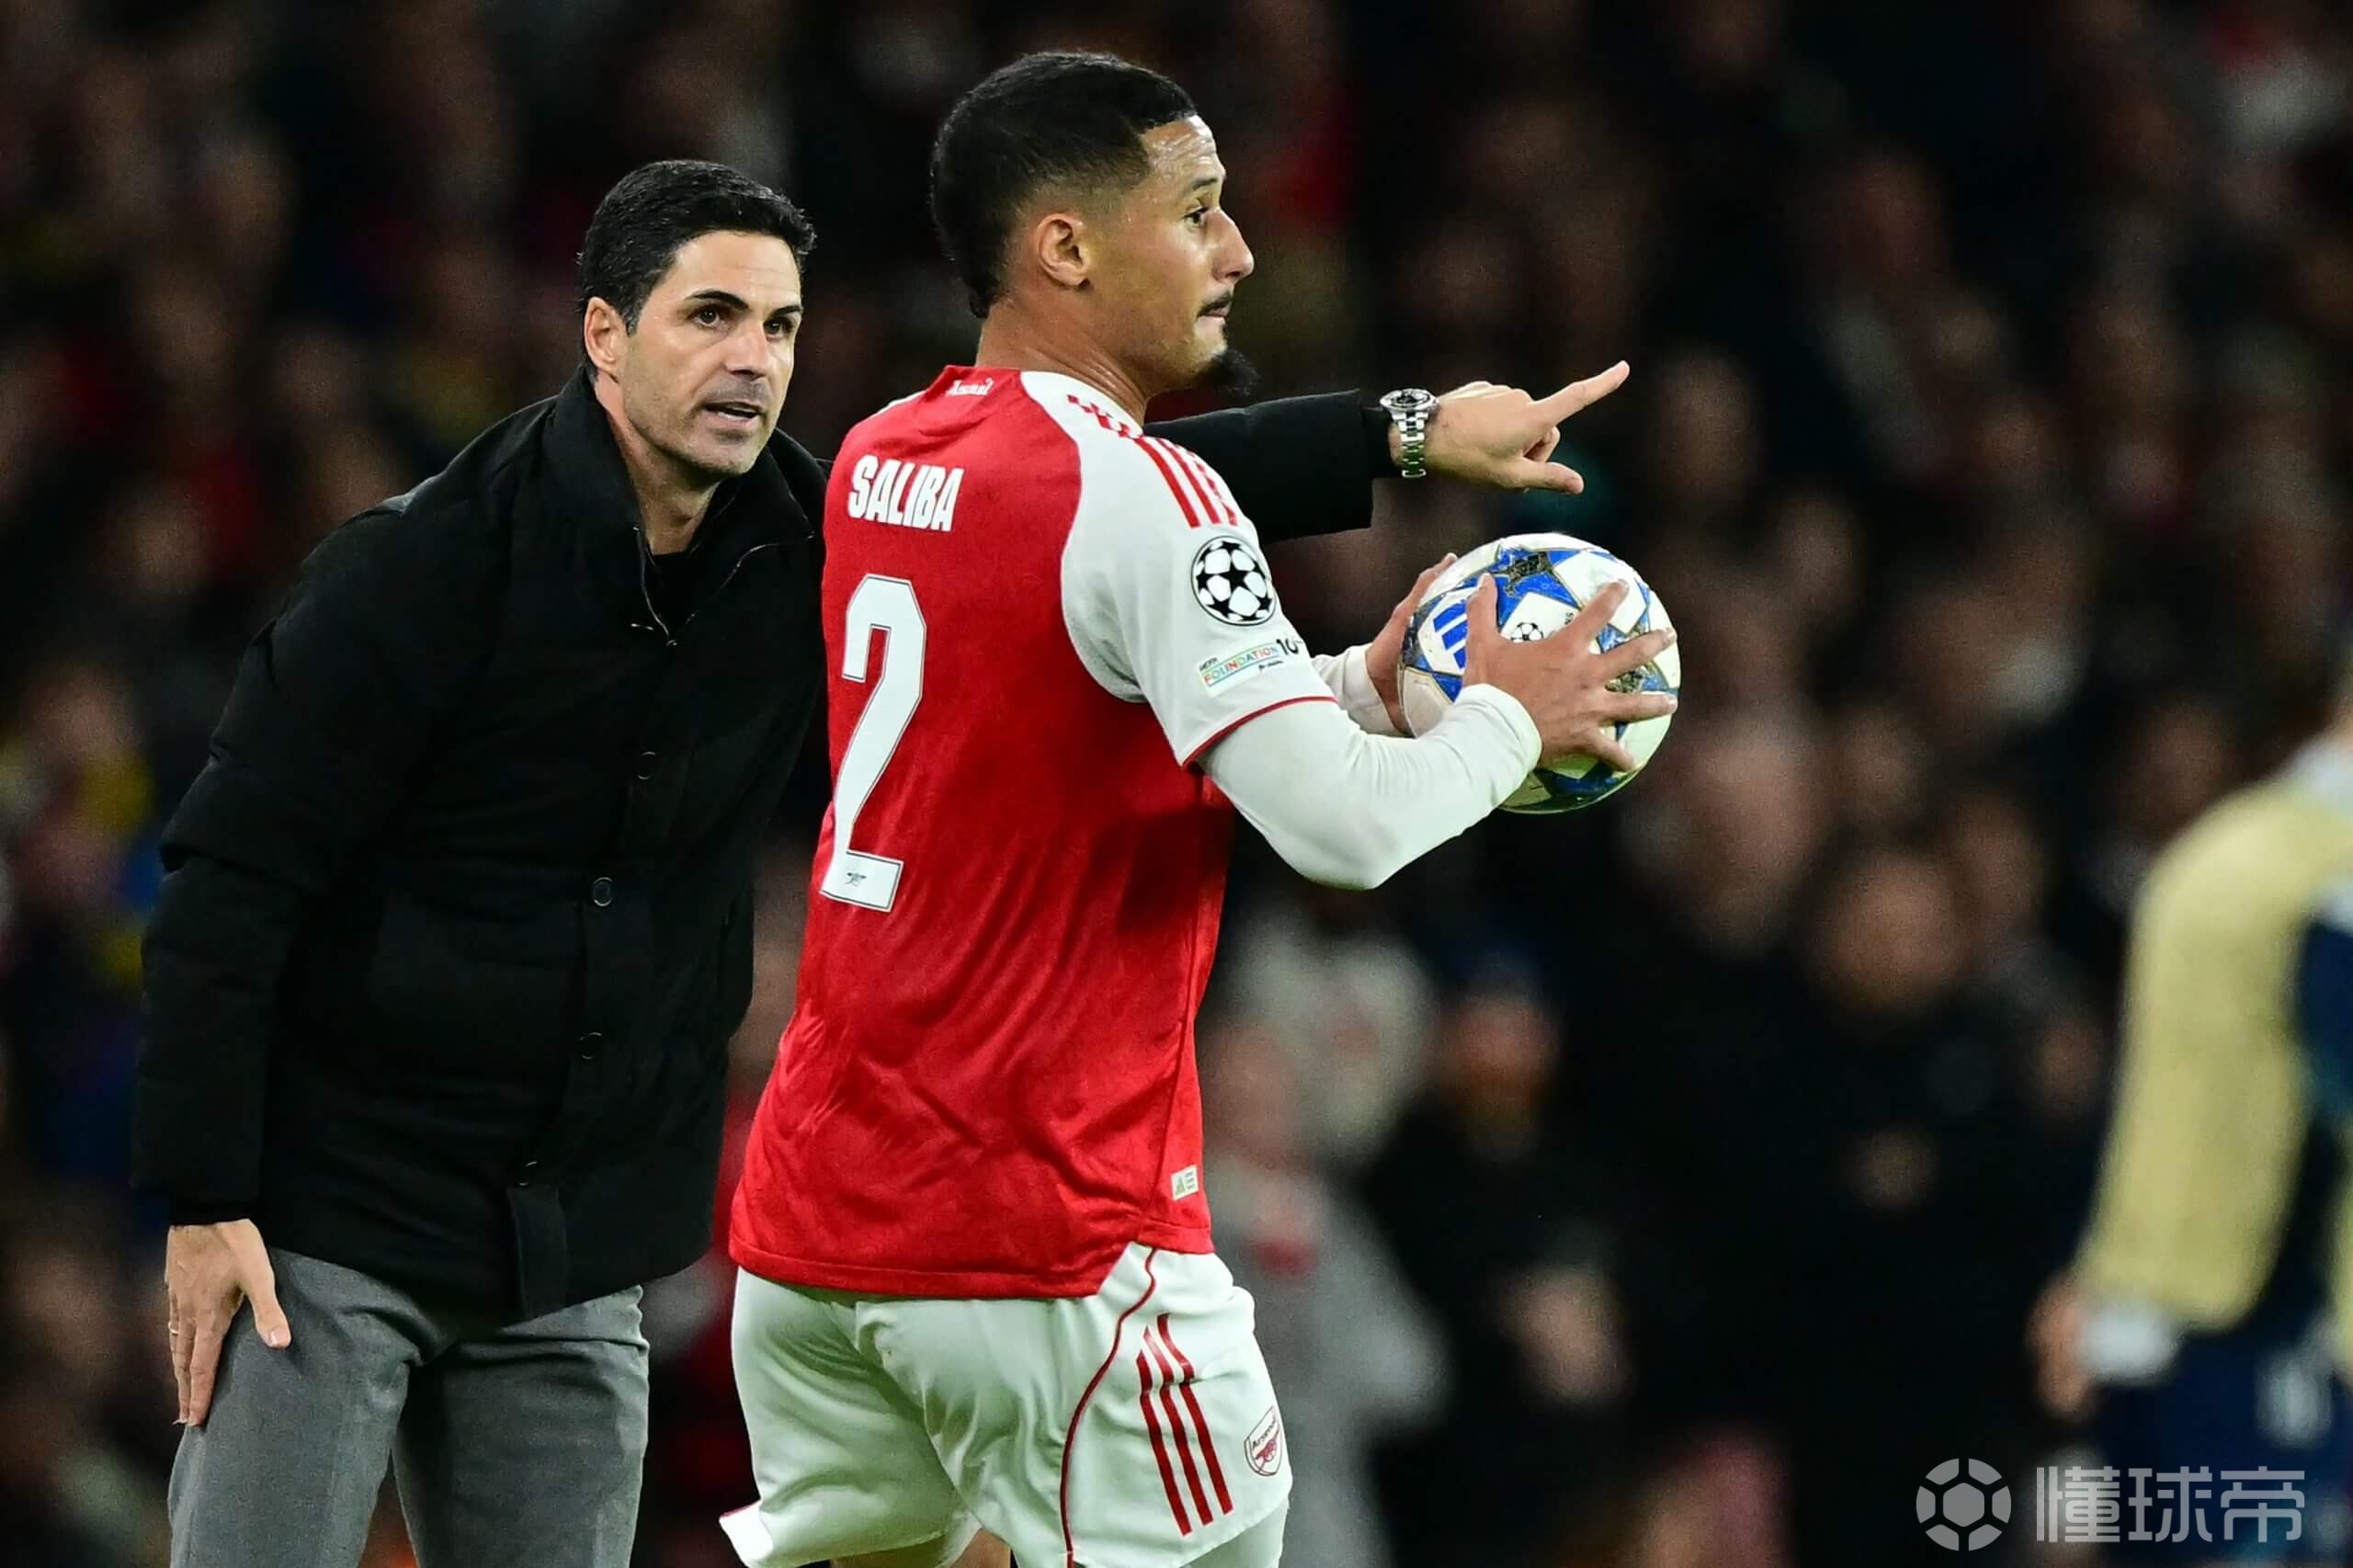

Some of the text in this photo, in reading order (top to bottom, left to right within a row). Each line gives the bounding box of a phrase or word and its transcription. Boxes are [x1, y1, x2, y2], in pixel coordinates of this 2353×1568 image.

[847, 454, 965, 532] SALIBA
[1203, 645, 1280, 686] FOUNDATION
[820, 574, 927, 912] 2
